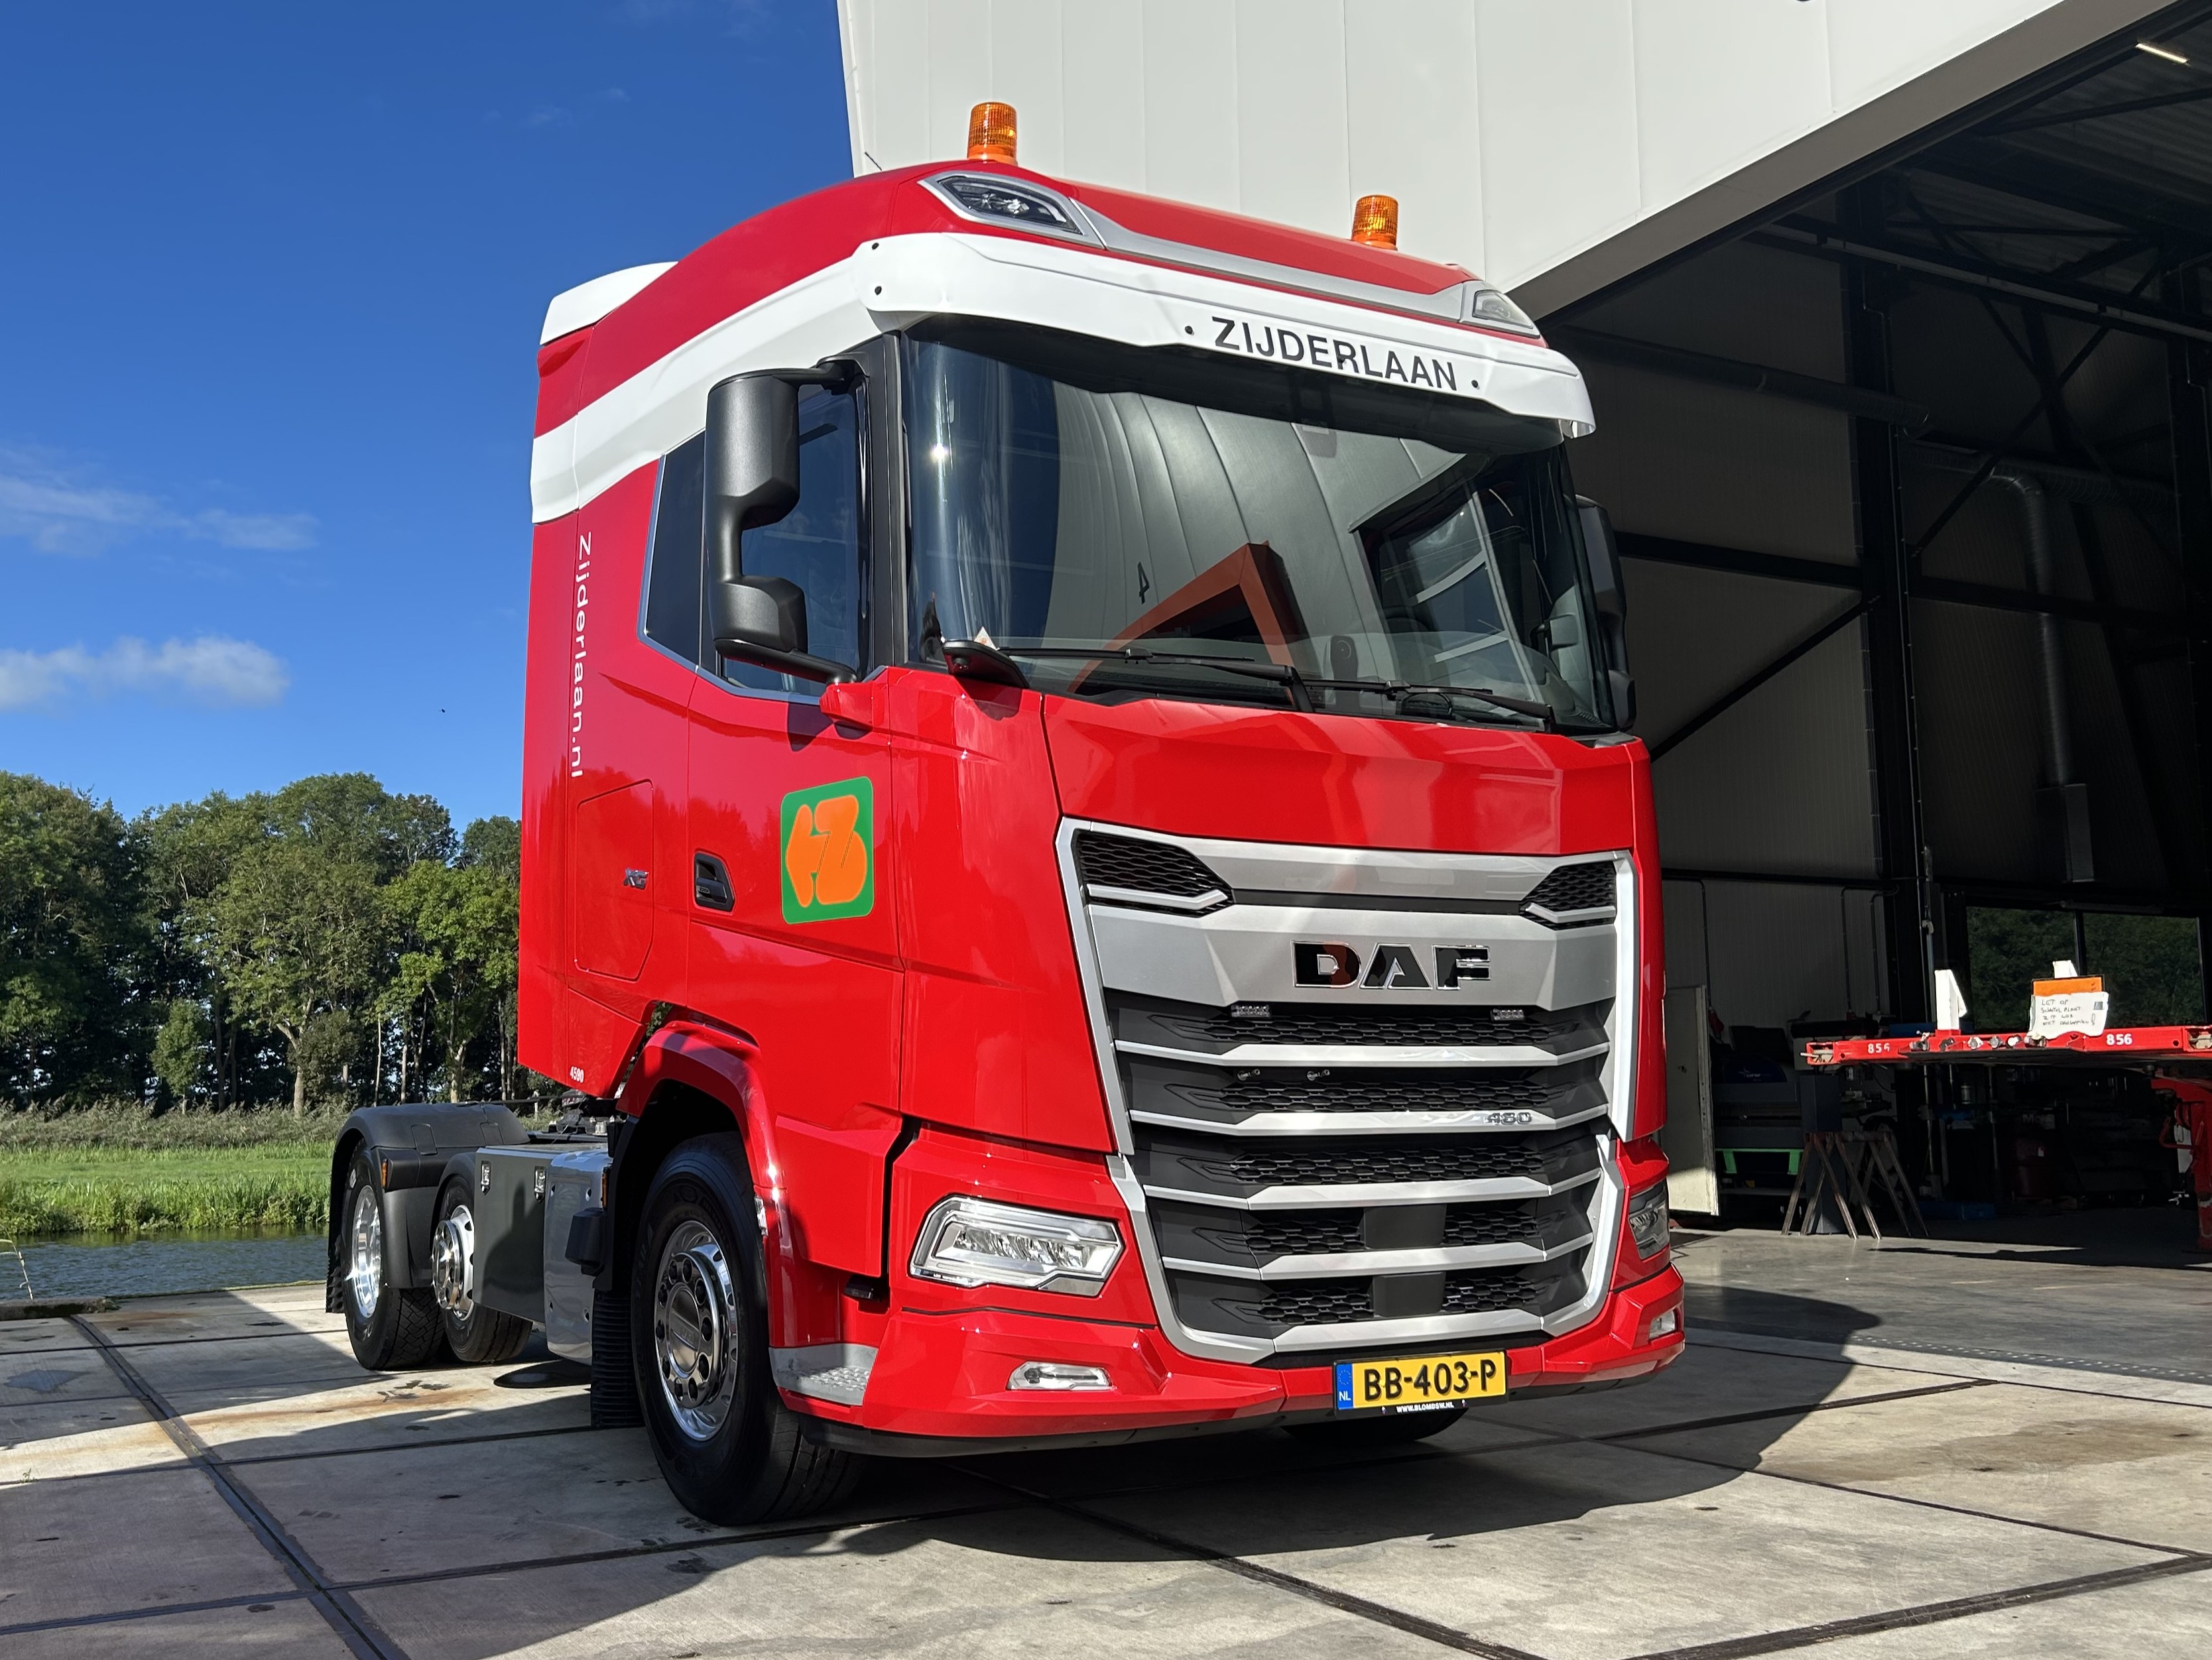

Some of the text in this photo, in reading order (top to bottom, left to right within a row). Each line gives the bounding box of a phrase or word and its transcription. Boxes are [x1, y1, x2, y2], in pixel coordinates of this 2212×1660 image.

[1211, 316, 1457, 391] ZIJDERLAAN
[571, 531, 591, 778] Zijderlaan.nl
[1290, 940, 1491, 990] DAF
[2106, 1034, 2132, 1045] 856
[570, 1066, 584, 1083] 4590
[1339, 1392, 1351, 1401] NL
[1363, 1359, 1496, 1401] BB-403-P
